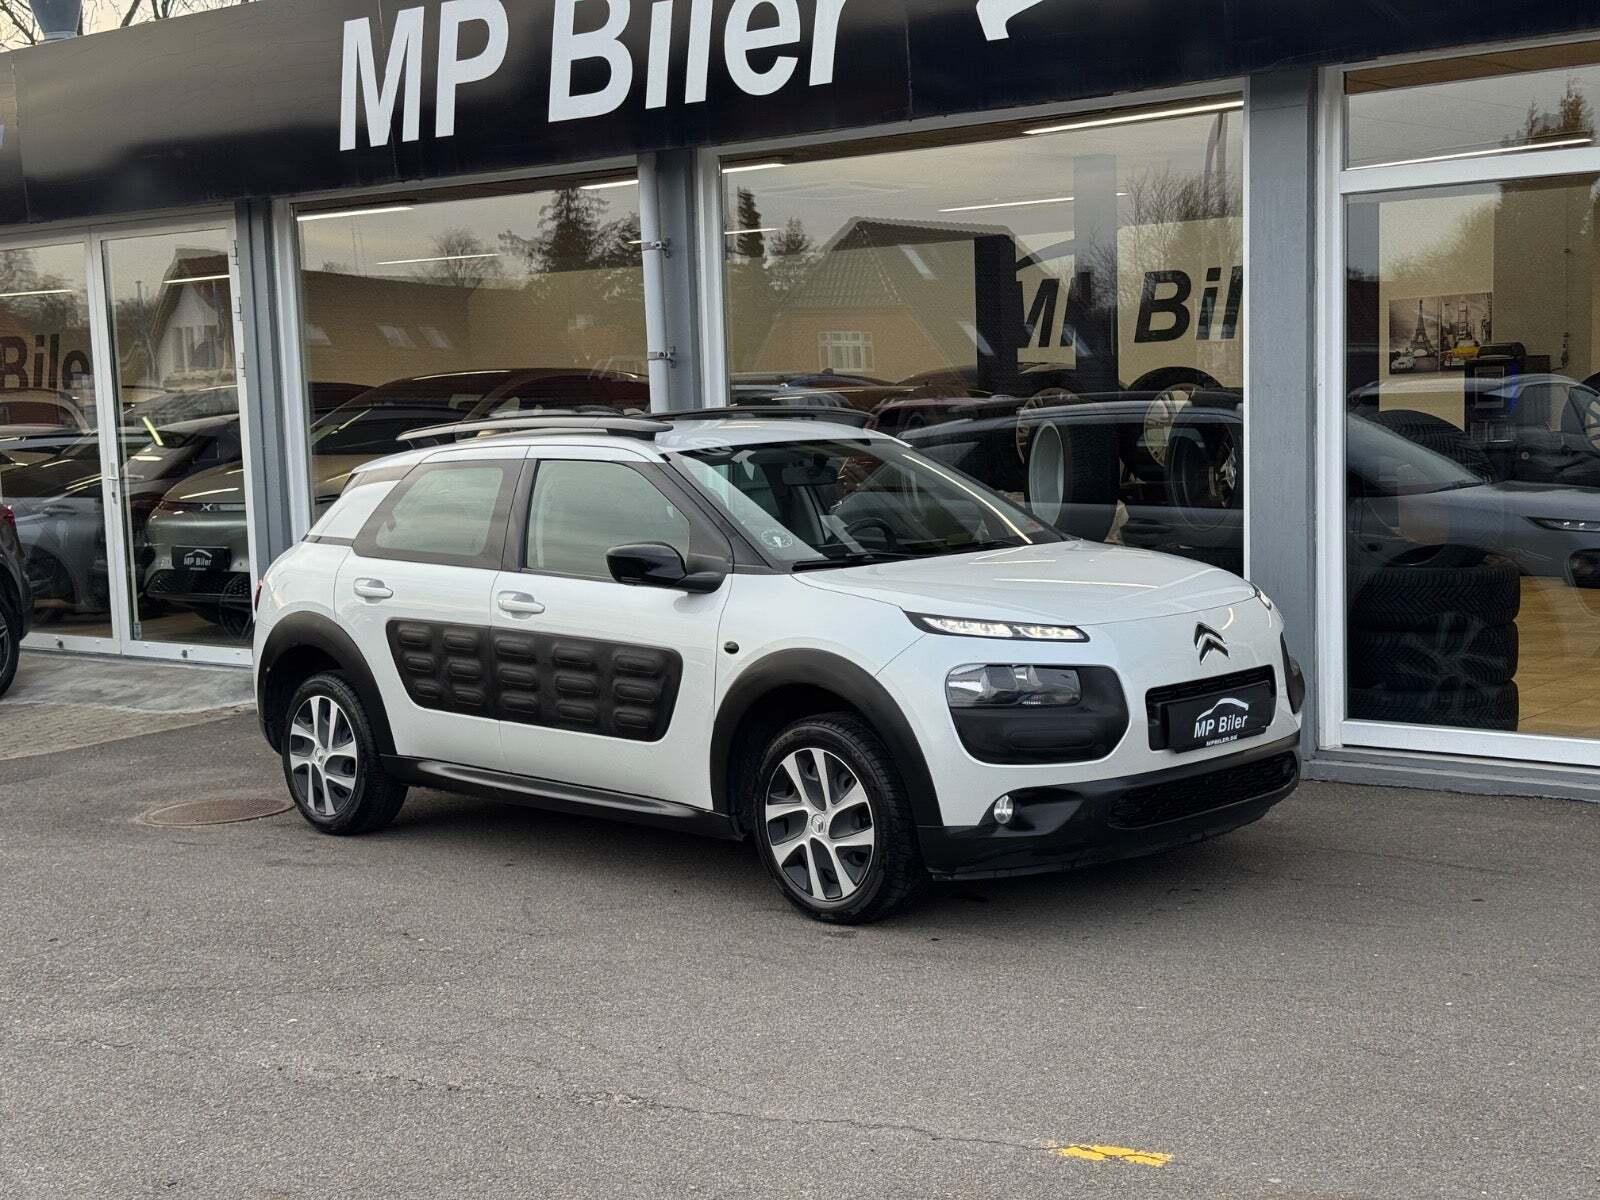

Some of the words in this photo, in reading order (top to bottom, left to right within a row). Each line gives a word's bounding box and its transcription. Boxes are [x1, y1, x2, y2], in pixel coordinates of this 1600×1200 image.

[339, 0, 509, 151] MP
[548, 0, 848, 123] Biler
[184, 557, 195, 566] MP
[1194, 719, 1215, 738] MP
[1218, 714, 1248, 733] Biler
